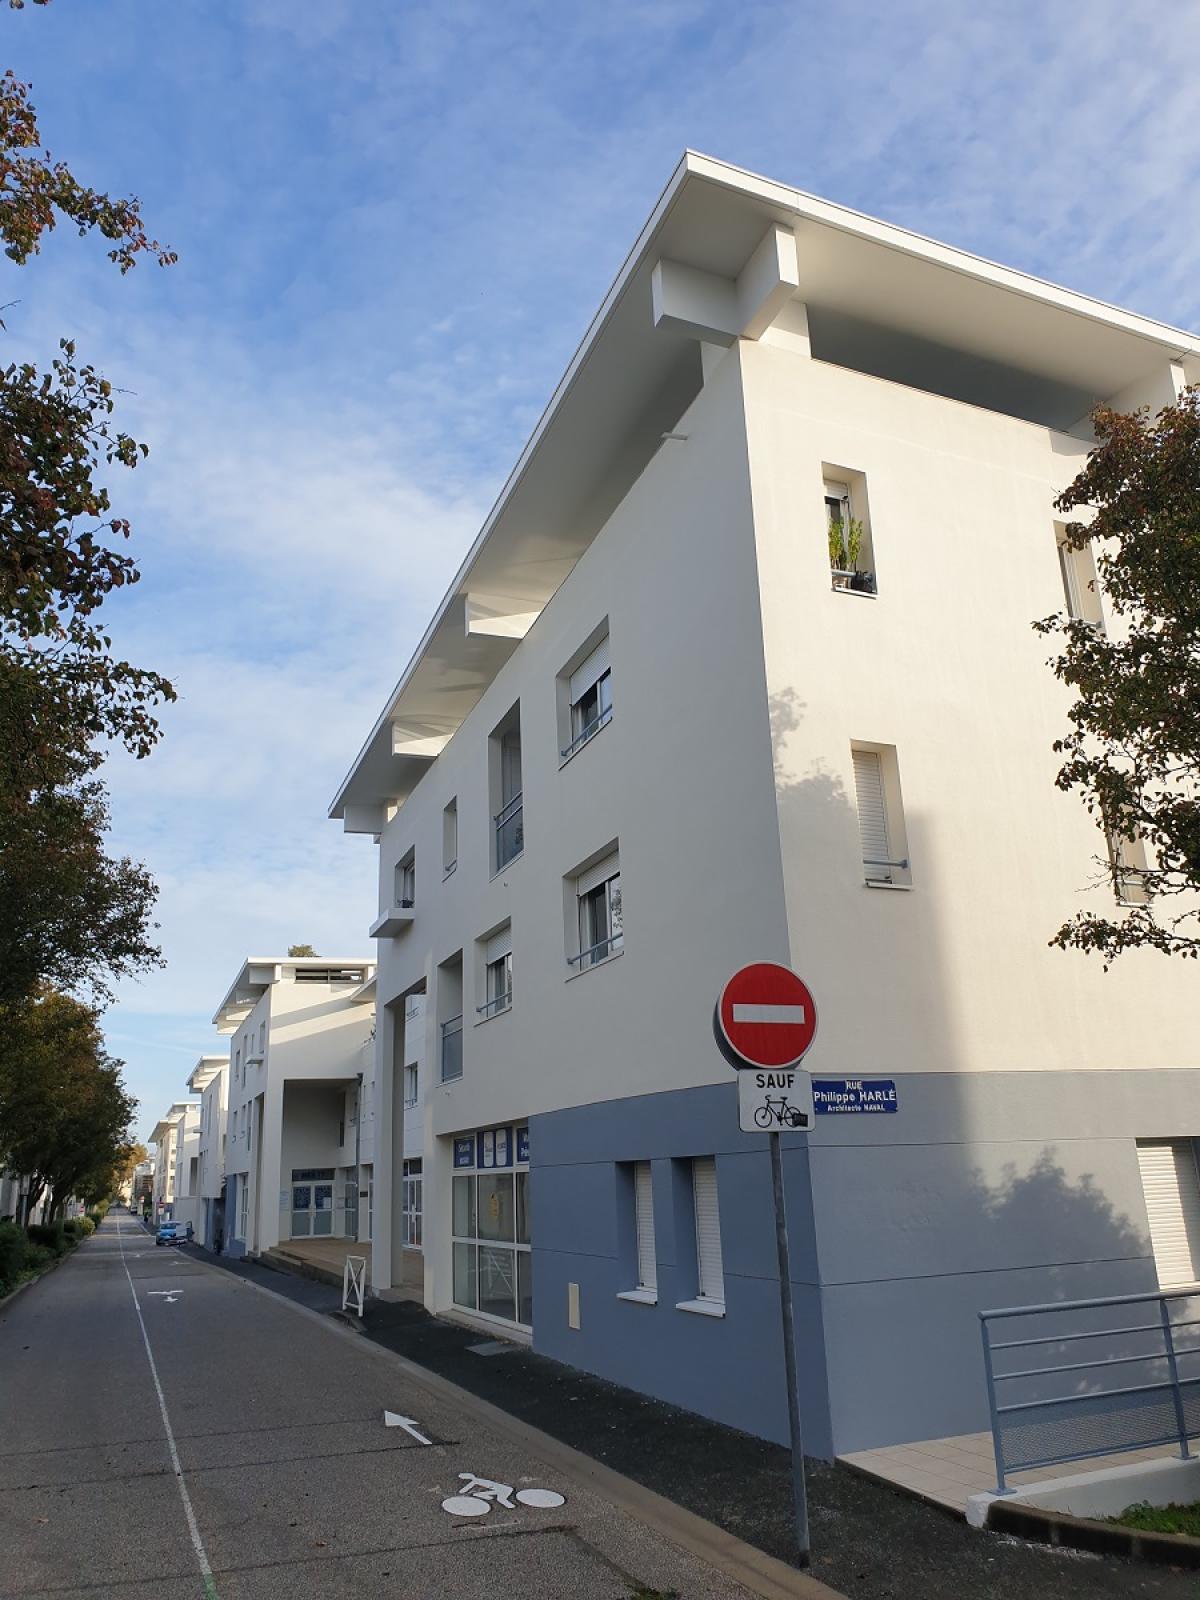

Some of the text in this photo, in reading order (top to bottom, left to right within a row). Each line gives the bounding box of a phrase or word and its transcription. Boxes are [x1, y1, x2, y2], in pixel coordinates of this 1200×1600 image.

[756, 1074, 795, 1088] SAUF
[845, 1080, 863, 1090] RUE
[814, 1089, 896, 1103] Philippe HARLÉ
